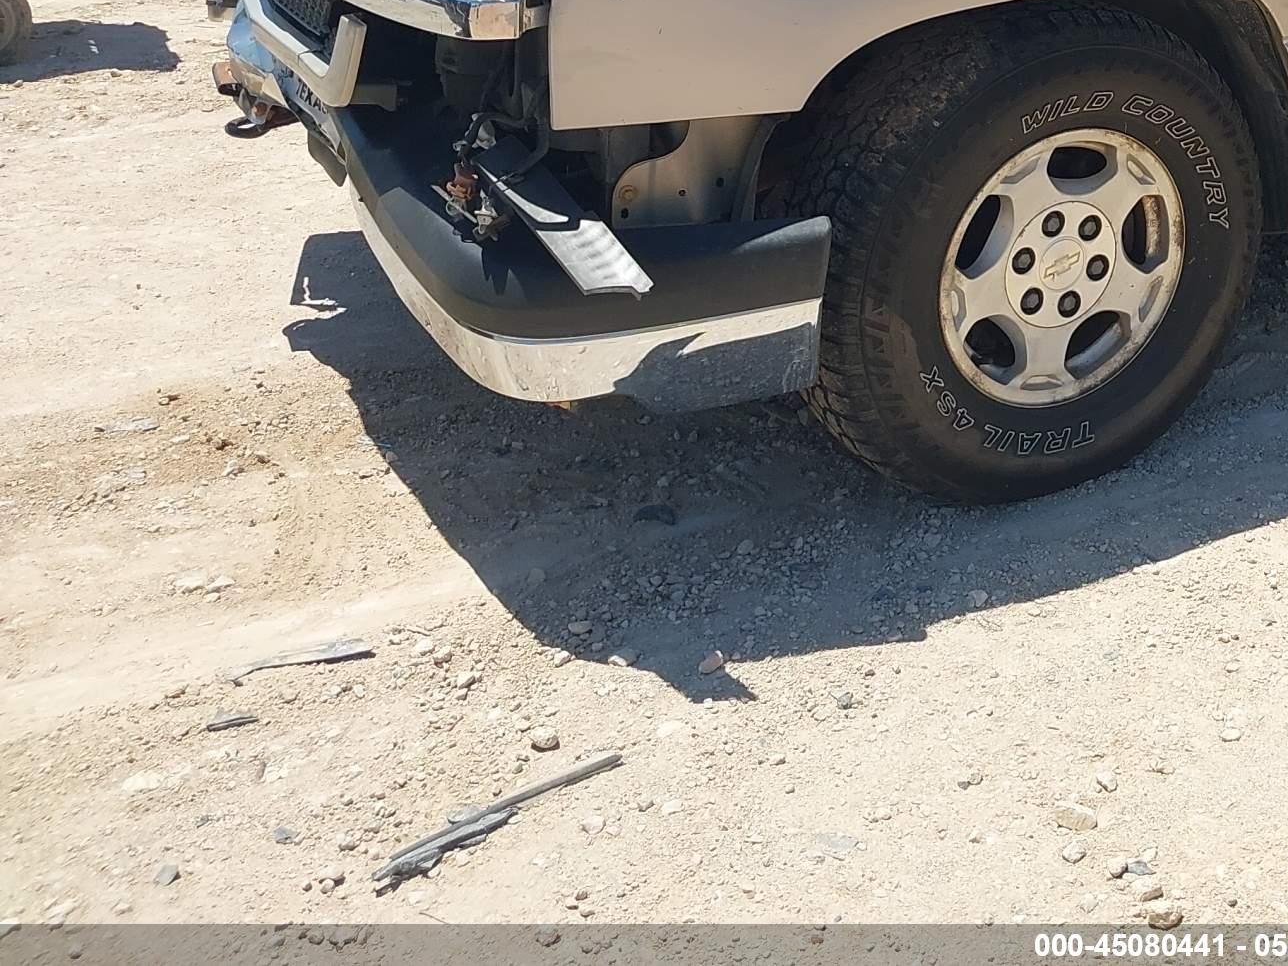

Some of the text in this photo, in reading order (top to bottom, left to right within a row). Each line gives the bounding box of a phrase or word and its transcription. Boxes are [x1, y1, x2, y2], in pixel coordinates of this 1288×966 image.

[1021, 91, 1230, 230] WILD COUNTRY
[919, 365, 1096, 455] TRAIL 4SX
